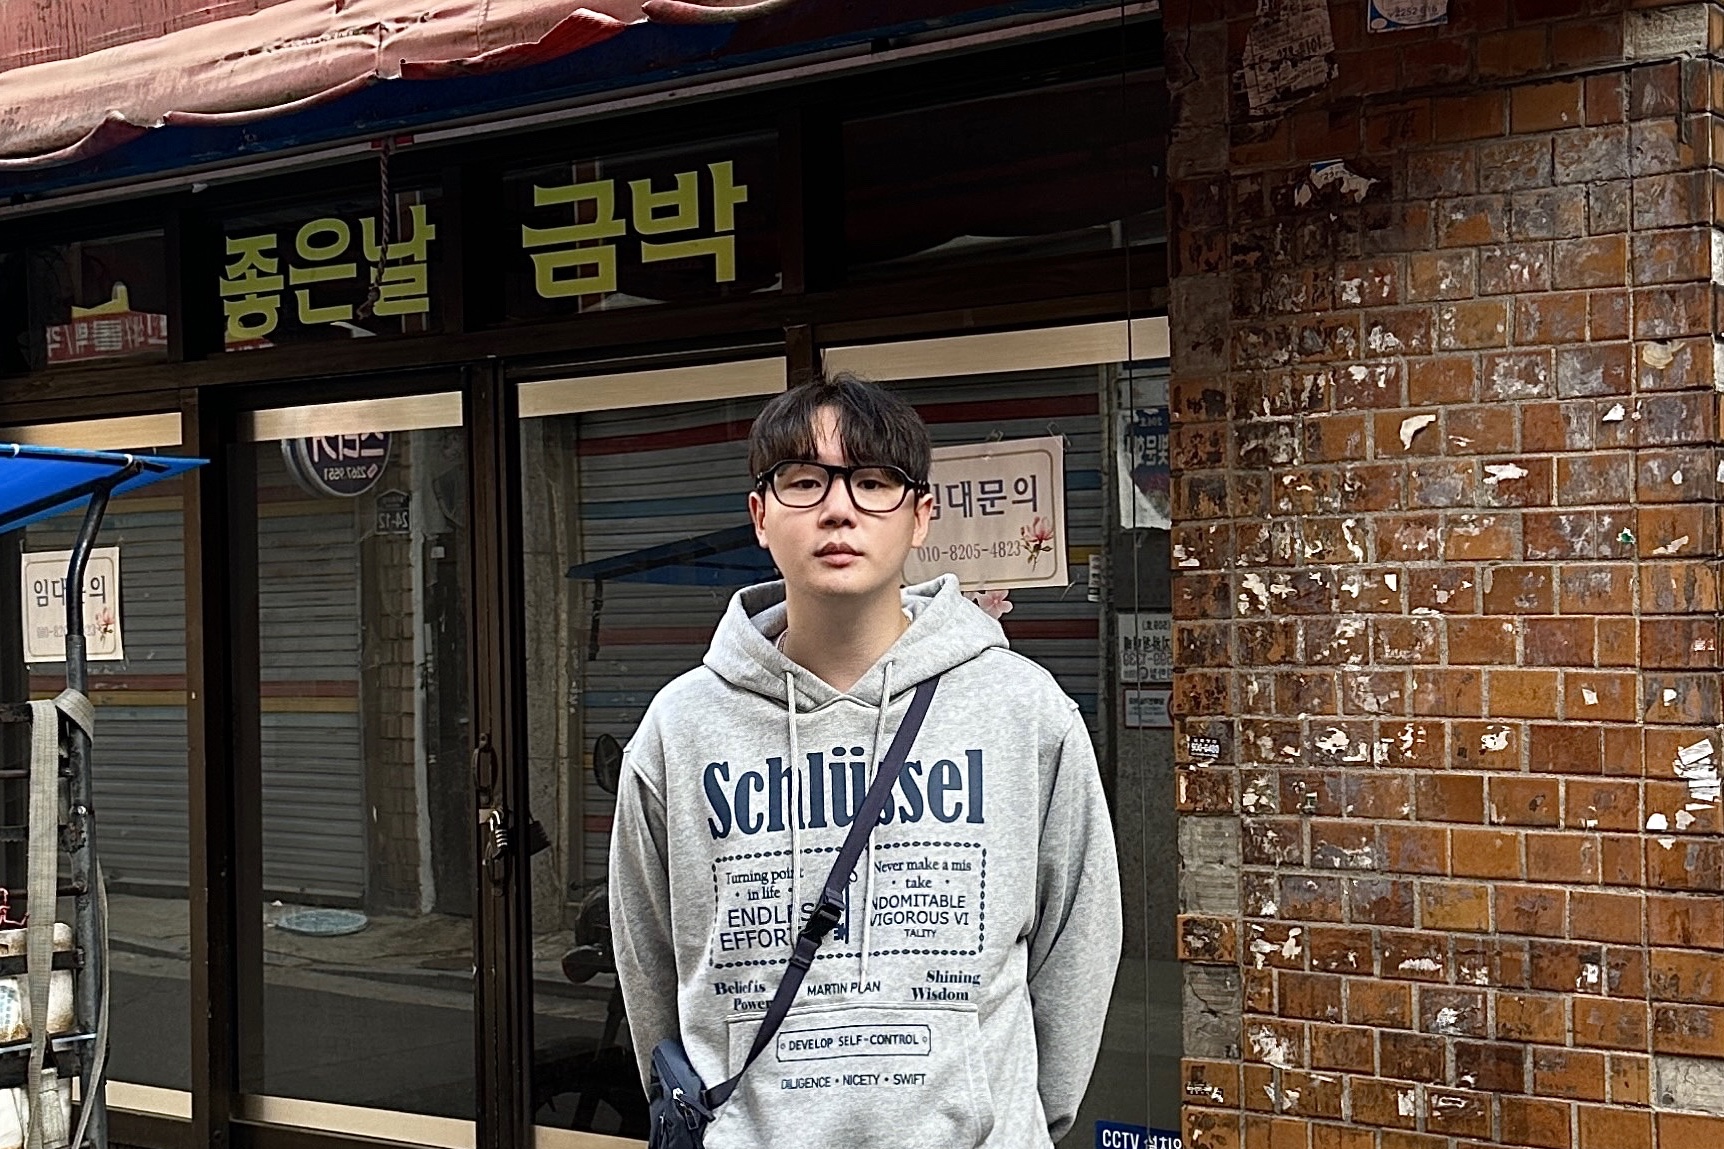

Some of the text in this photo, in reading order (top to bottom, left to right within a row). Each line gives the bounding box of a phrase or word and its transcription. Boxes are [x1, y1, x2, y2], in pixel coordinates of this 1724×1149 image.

[219, 160, 748, 339] 좋은날 금박
[917, 540, 1021, 563] 010-8205-4823
[34, 575, 105, 607] 임대의
[874, 856, 972, 873] Never make a mis
[725, 869, 769, 885] Turning
[905, 875, 932, 889] take
[747, 885, 781, 900] in life
[870, 910, 969, 927] VIGOROUS VI
[904, 928, 937, 938] TALITY
[925, 969, 982, 985] Shining
[713, 979, 766, 995] Belief is
[807, 982, 848, 996] MARTIN
[911, 987, 969, 1001] Wisdom
[788, 1033, 919, 1051] DEVELOP SELF-CONTROL
[781, 1073, 926, 1090] DILIGENCE NICETY SWIFT
